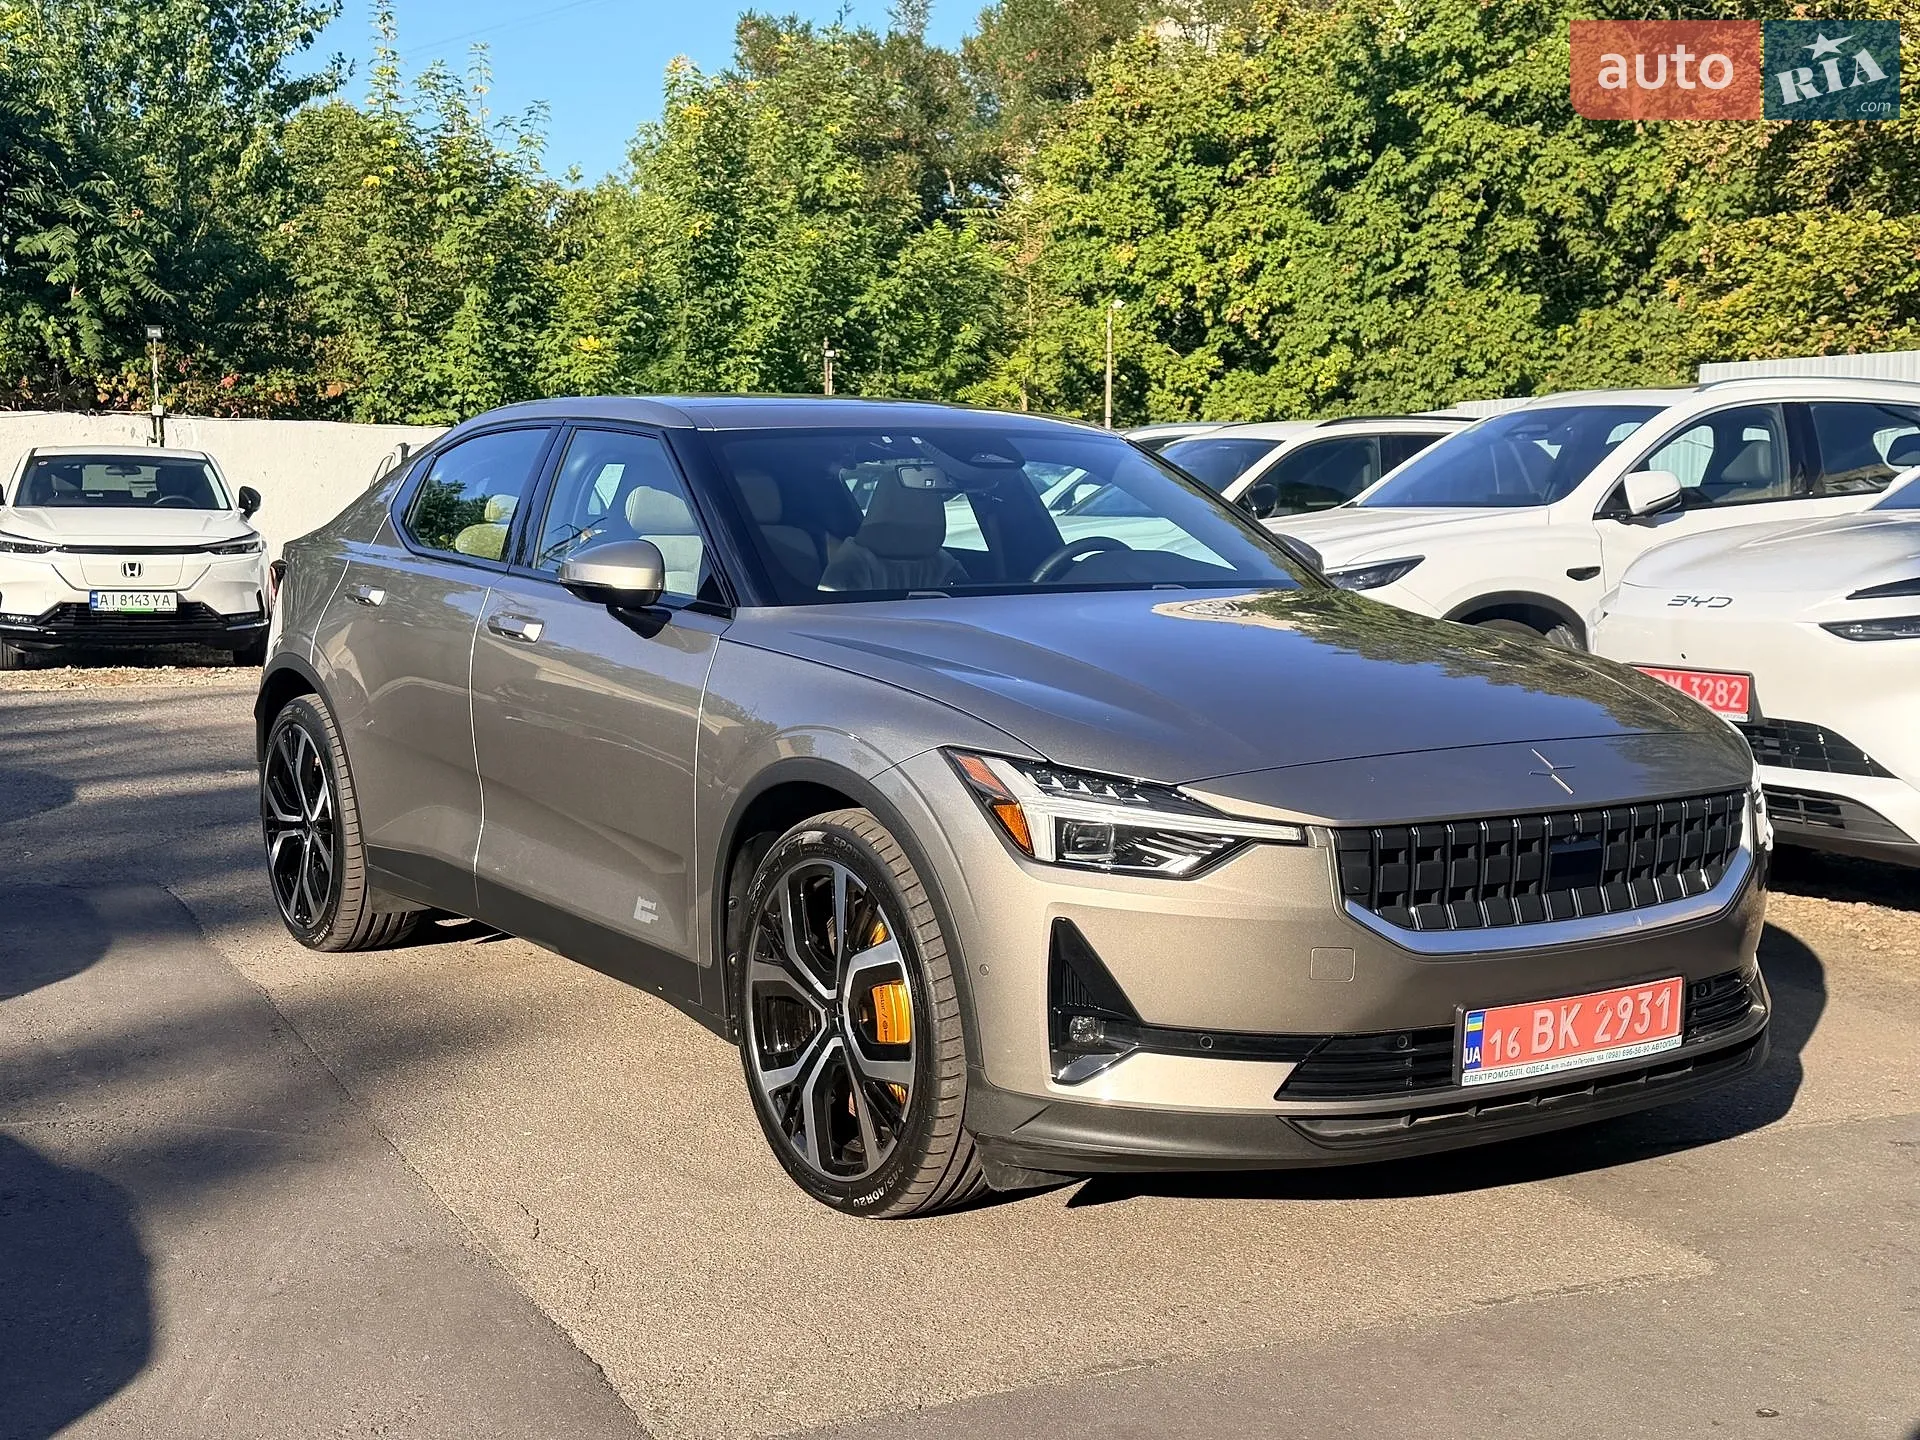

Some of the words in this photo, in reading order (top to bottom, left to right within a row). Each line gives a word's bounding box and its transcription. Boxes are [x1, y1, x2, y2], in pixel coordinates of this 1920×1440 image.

[119, 594, 150, 606] 8143
[1690, 676, 1743, 709] 3282
[1489, 1026, 1521, 1062] 16
[1531, 1003, 1582, 1055] BK
[1593, 986, 1671, 1044] 2931
[1465, 1047, 1481, 1064] UA
[1525, 1063, 1550, 1077] ОДЕСА
